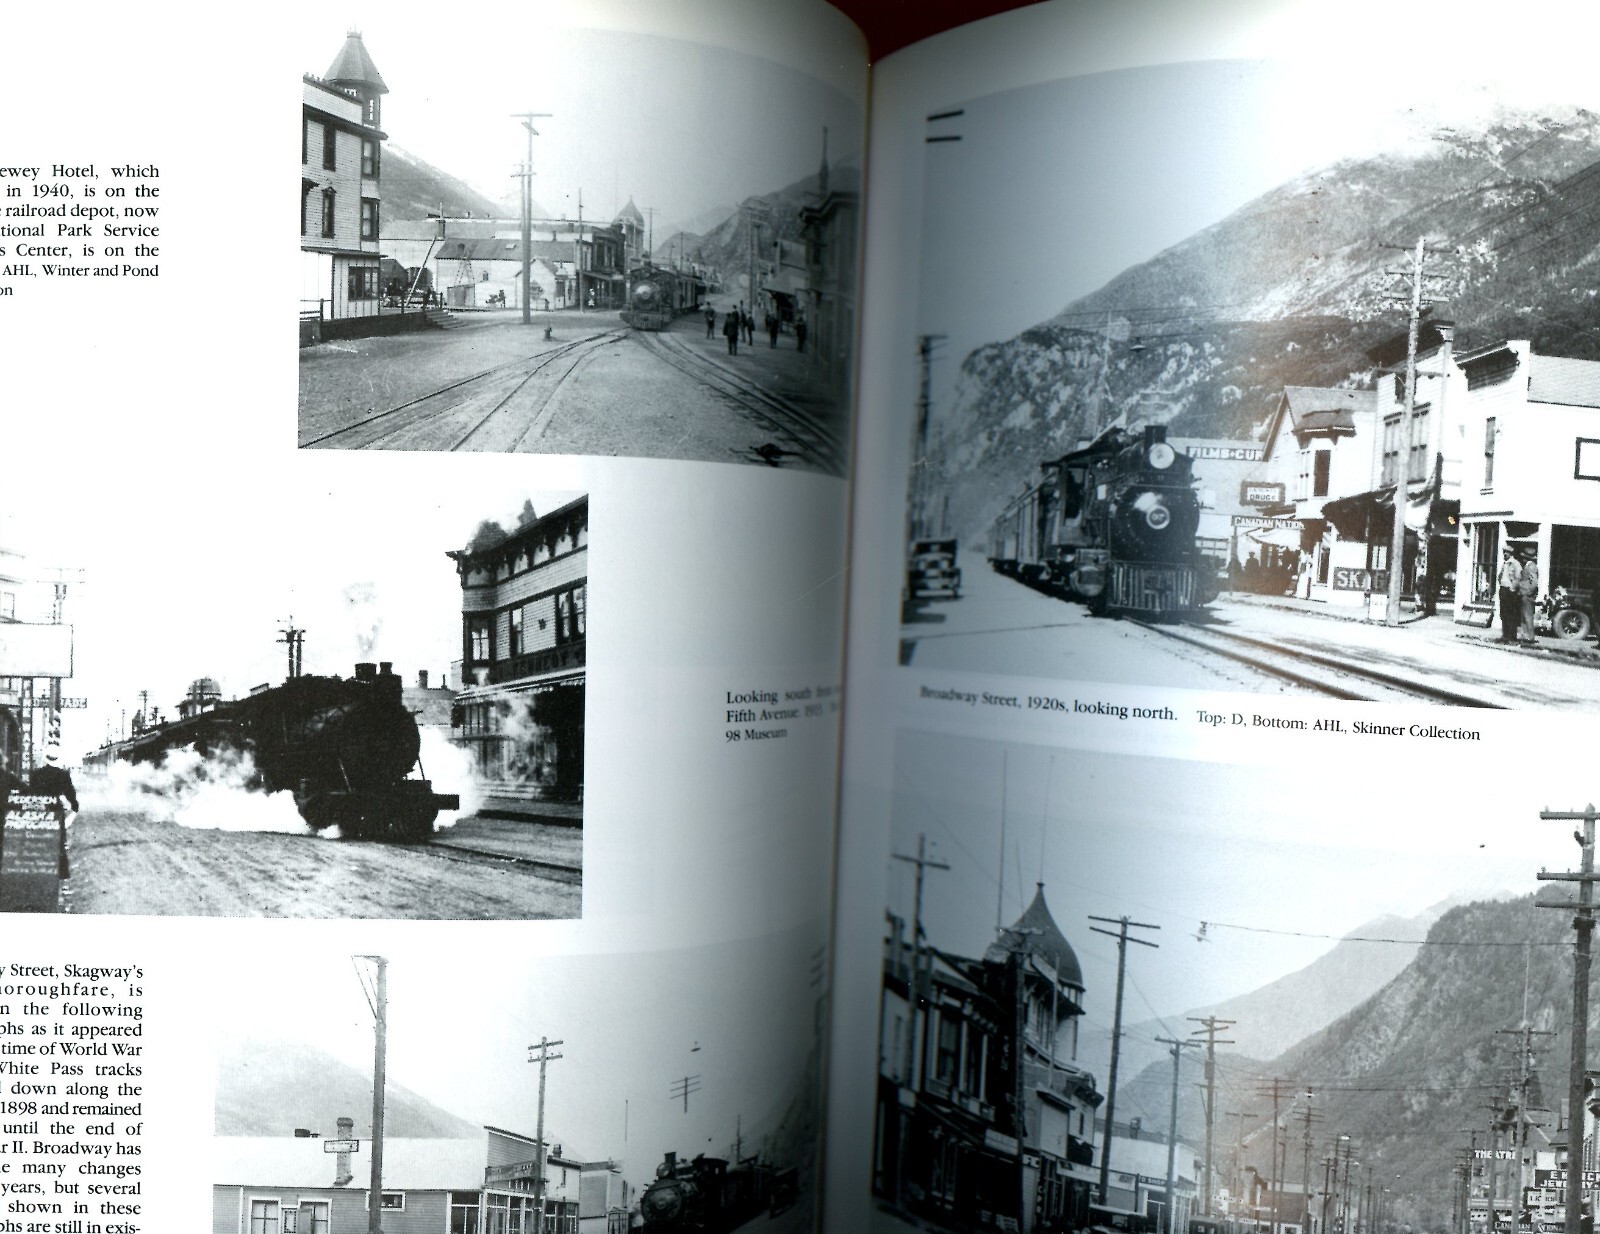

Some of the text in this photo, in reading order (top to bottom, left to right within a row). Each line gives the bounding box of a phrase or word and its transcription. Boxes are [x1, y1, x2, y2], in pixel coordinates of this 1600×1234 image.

[53, 165, 98, 179] Hotel,
[111, 165, 159, 177] which
[7, 183, 159, 199] in 1940, is on the
[6, 204, 66, 217] railroad
[71, 204, 118, 220] depot,
[124, 208, 159, 217] now
[58, 224, 92, 236] Park
[104, 224, 159, 236] Service
[16, 244, 71, 258] Center,
[83, 244, 94, 256] is
[105, 247, 124, 256] on
[135, 244, 159, 256] the
[2, 265, 158, 277] AHL, Winter and Pond
[727, 690, 778, 705] Looking
[726, 710, 756, 723] Fifth
[760, 708, 799, 721] Avenue
[920, 685, 1480, 740] Broadway Street, 1920s, looking north. Top: D, Bottom: AHL, Skinner Collection
[725, 728, 788, 743] 98 Museum
[11, 964, 58, 979] Street,
[65, 964, 143, 981] Skagway's
[129, 984, 142, 996] is
[24, 1002, 49, 1015] the
[63, 1002, 142, 1020] following
[32, 1025, 46, 1035] as
[54, 1023, 64, 1035] it
[72, 1023, 142, 1039] appeared
[2, 1042, 142, 1056] time of World War
[51, 1062, 83, 1075] Pass
[96, 1063, 142, 1076] tracks
[11, 1082, 56, 1094] down
[66, 1082, 108, 1099] along
[118, 1083, 142, 1096] the
[1, 1102, 141, 1115] 1898 and remained
[4, 1121, 143, 1135] until the end of
[12, 1141, 27, 1153] II.
[33, 1141, 112, 1158] Broadway
[116, 1142, 141, 1155] has
[23, 1164, 66, 1177] many
[79, 1161, 141, 1179] changes
[1, 1181, 140, 1196] years, but several
[8, 1200, 141, 1214] shown in these
[27, 1223, 50, 1234] are
[55, 1221, 82, 1234] still
[87, 1221, 101, 1234] in
[106, 1221, 140, 1234] exis-
